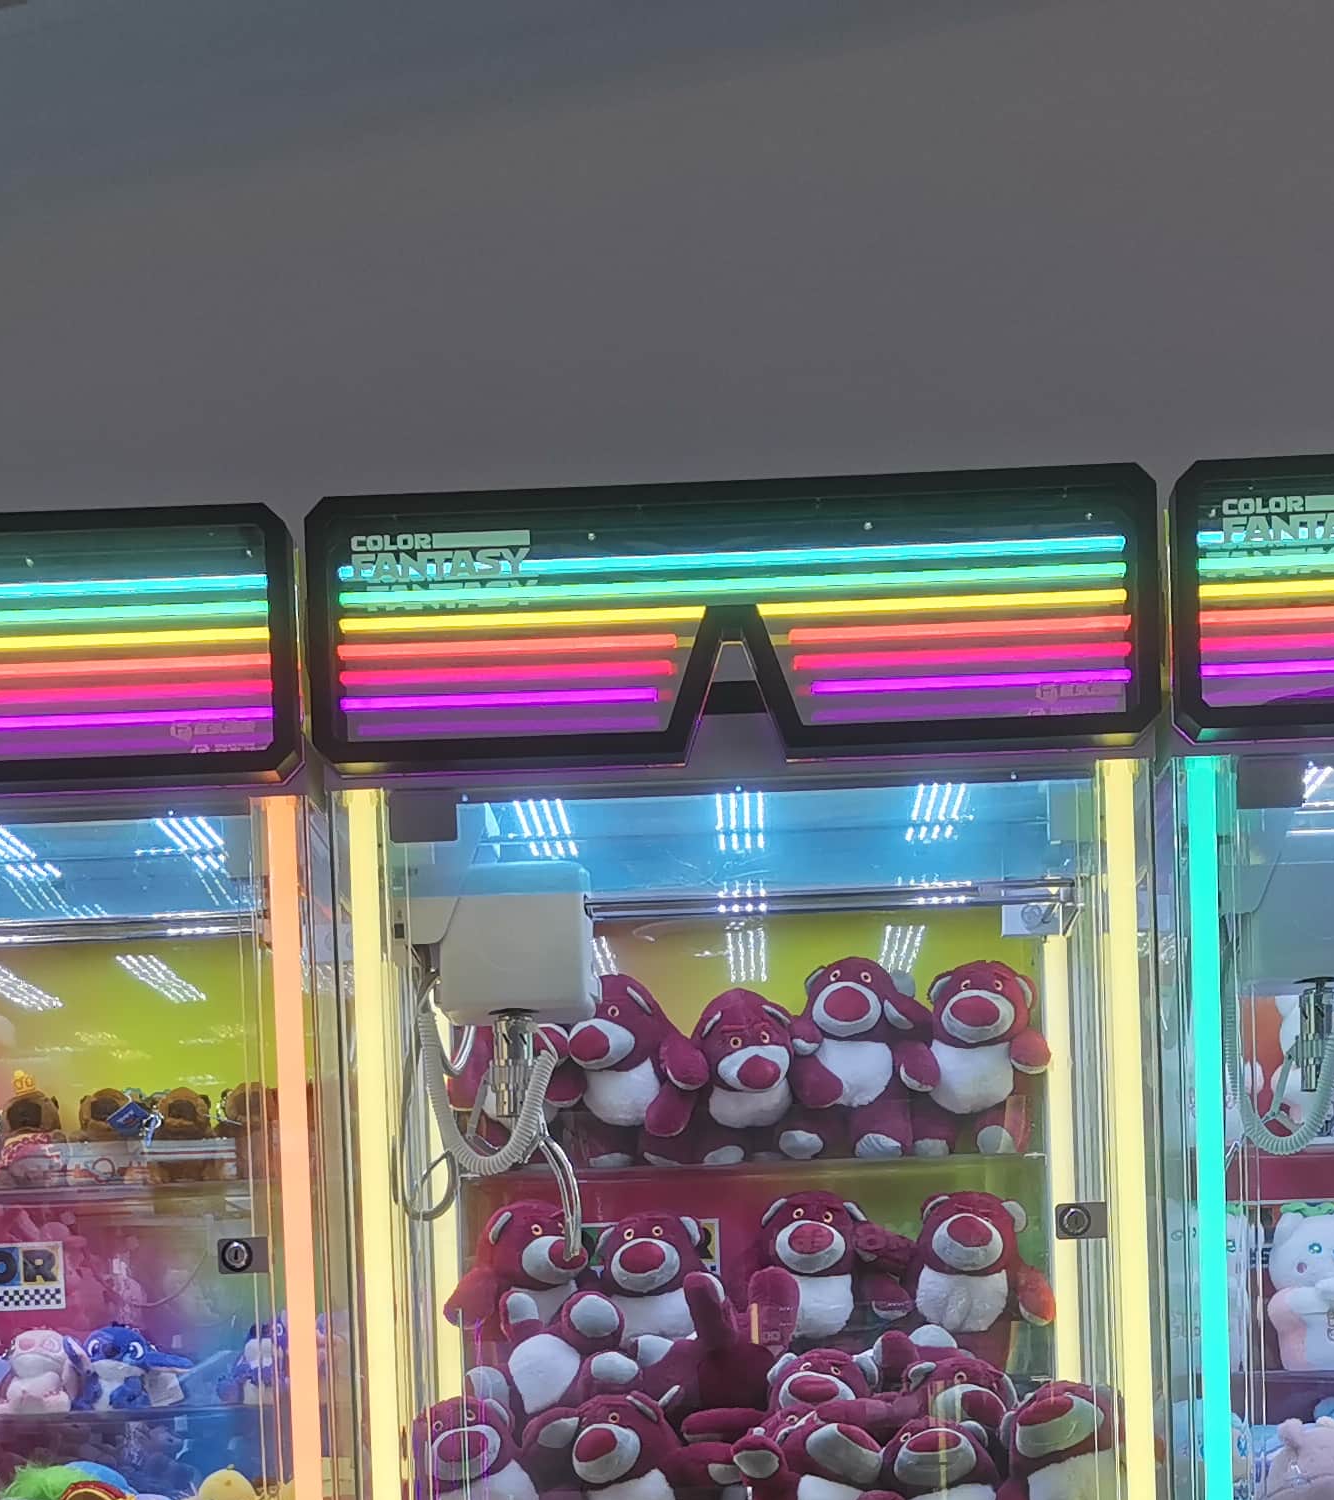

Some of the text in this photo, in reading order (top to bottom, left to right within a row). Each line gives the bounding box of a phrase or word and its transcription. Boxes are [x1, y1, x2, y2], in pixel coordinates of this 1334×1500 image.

[1222, 495, 1306, 515] COLOR
[350, 533, 433, 551] COLOR
[351, 547, 531, 582] FANTASY
